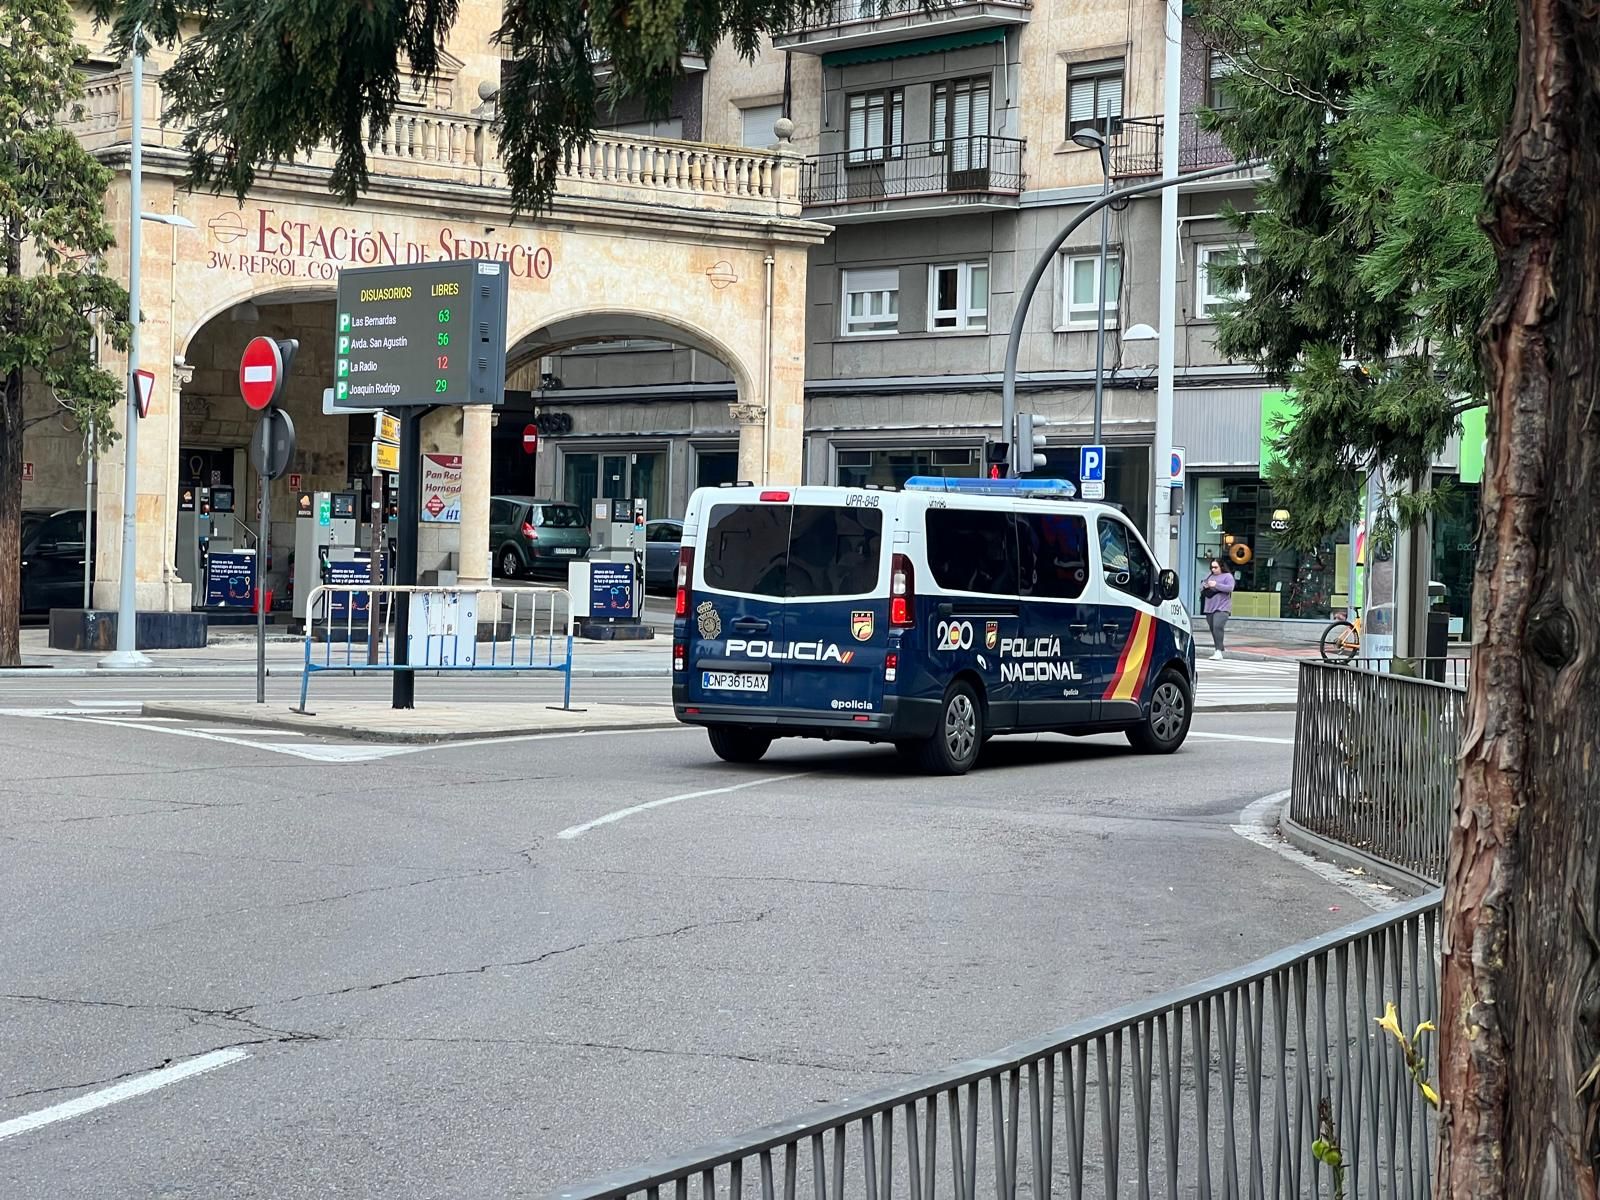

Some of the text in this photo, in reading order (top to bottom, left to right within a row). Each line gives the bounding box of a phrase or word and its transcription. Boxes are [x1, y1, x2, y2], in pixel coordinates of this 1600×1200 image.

[407, 242, 429, 264] DE
[360, 283, 459, 302] DISUASORIOS LIBRES
[352, 317, 363, 327] Las
[364, 315, 396, 326] Bernardas
[438, 310, 450, 322] 63
[351, 340, 368, 349] Avda.
[370, 338, 382, 348] San
[383, 336, 408, 349] Agustín
[438, 333, 449, 346] 56
[350, 362, 358, 372] La
[360, 361, 378, 371] Radio
[437, 356, 448, 369] 12
[349, 384, 374, 396] Joaquín
[376, 383, 400, 395] Rodrigo
[436, 380, 447, 392] 29
[1085, 451, 1099, 476] P
[937, 621, 973, 650] 200
[726, 639, 842, 662] POLICÍA
[1000, 634, 1060, 658] POLICÍA
[708, 674, 767, 689] CNP3615AX
[1001, 662, 1082, 682] NACIONAL
[831, 699, 872, 710] @policia
